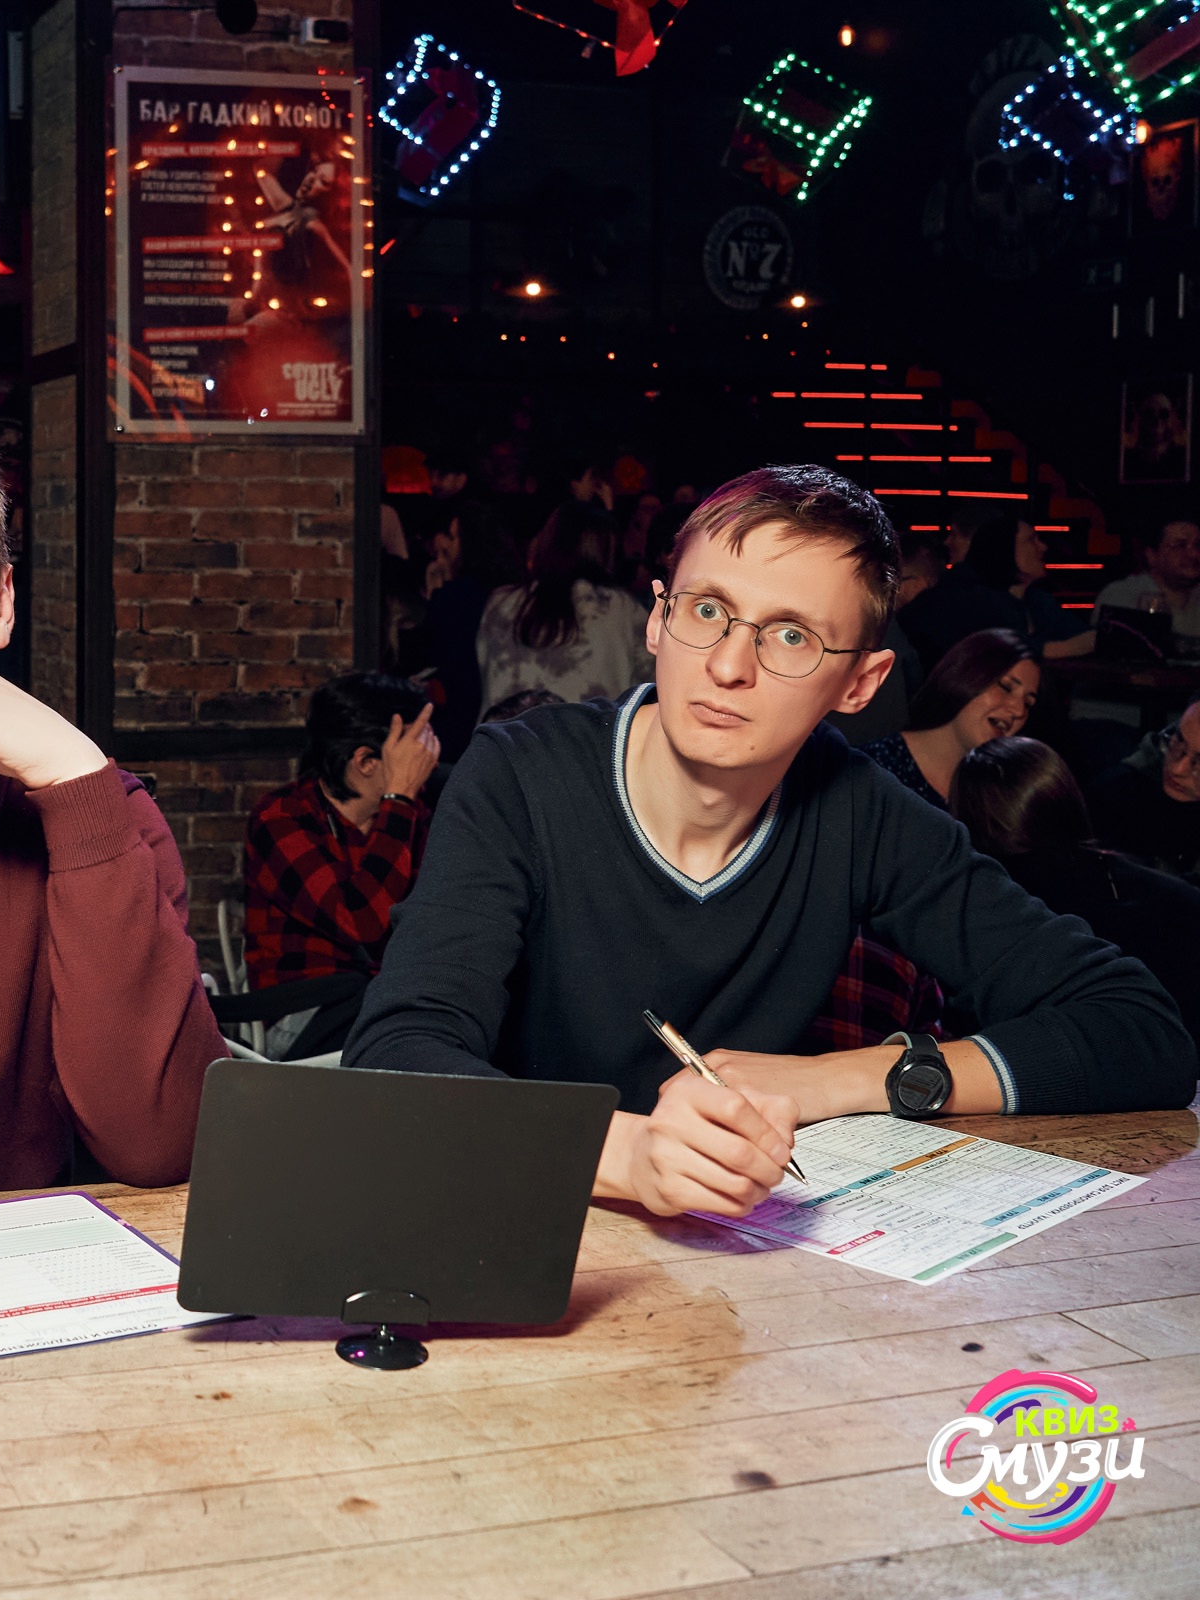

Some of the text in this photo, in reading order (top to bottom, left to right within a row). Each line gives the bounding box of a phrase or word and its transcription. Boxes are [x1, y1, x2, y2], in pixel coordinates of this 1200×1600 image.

[139, 99, 345, 130] БАР ГАДКИЙ КОЙОТ
